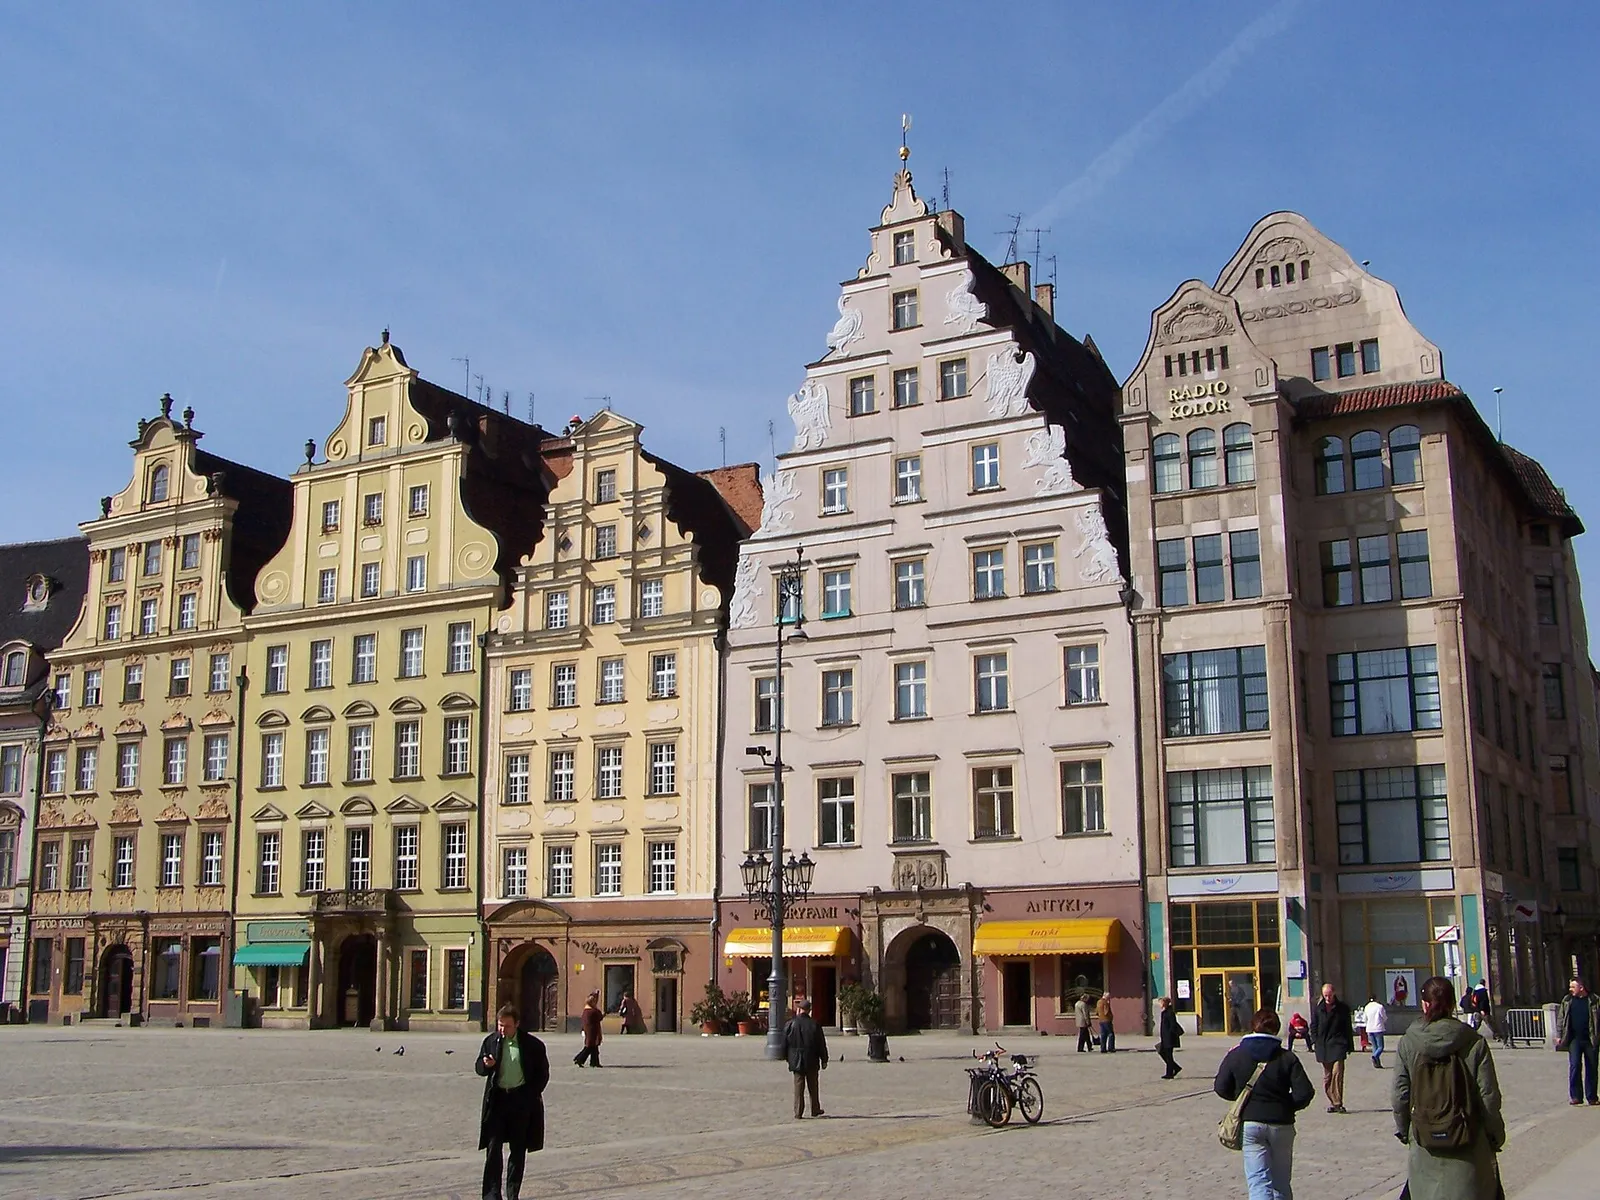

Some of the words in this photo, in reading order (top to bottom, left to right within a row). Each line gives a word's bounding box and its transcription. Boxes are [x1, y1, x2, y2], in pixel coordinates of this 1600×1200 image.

[1169, 380, 1229, 402] RADIO
[1169, 399, 1231, 420] KOLOR
[1026, 899, 1081, 913] ANTYKI
